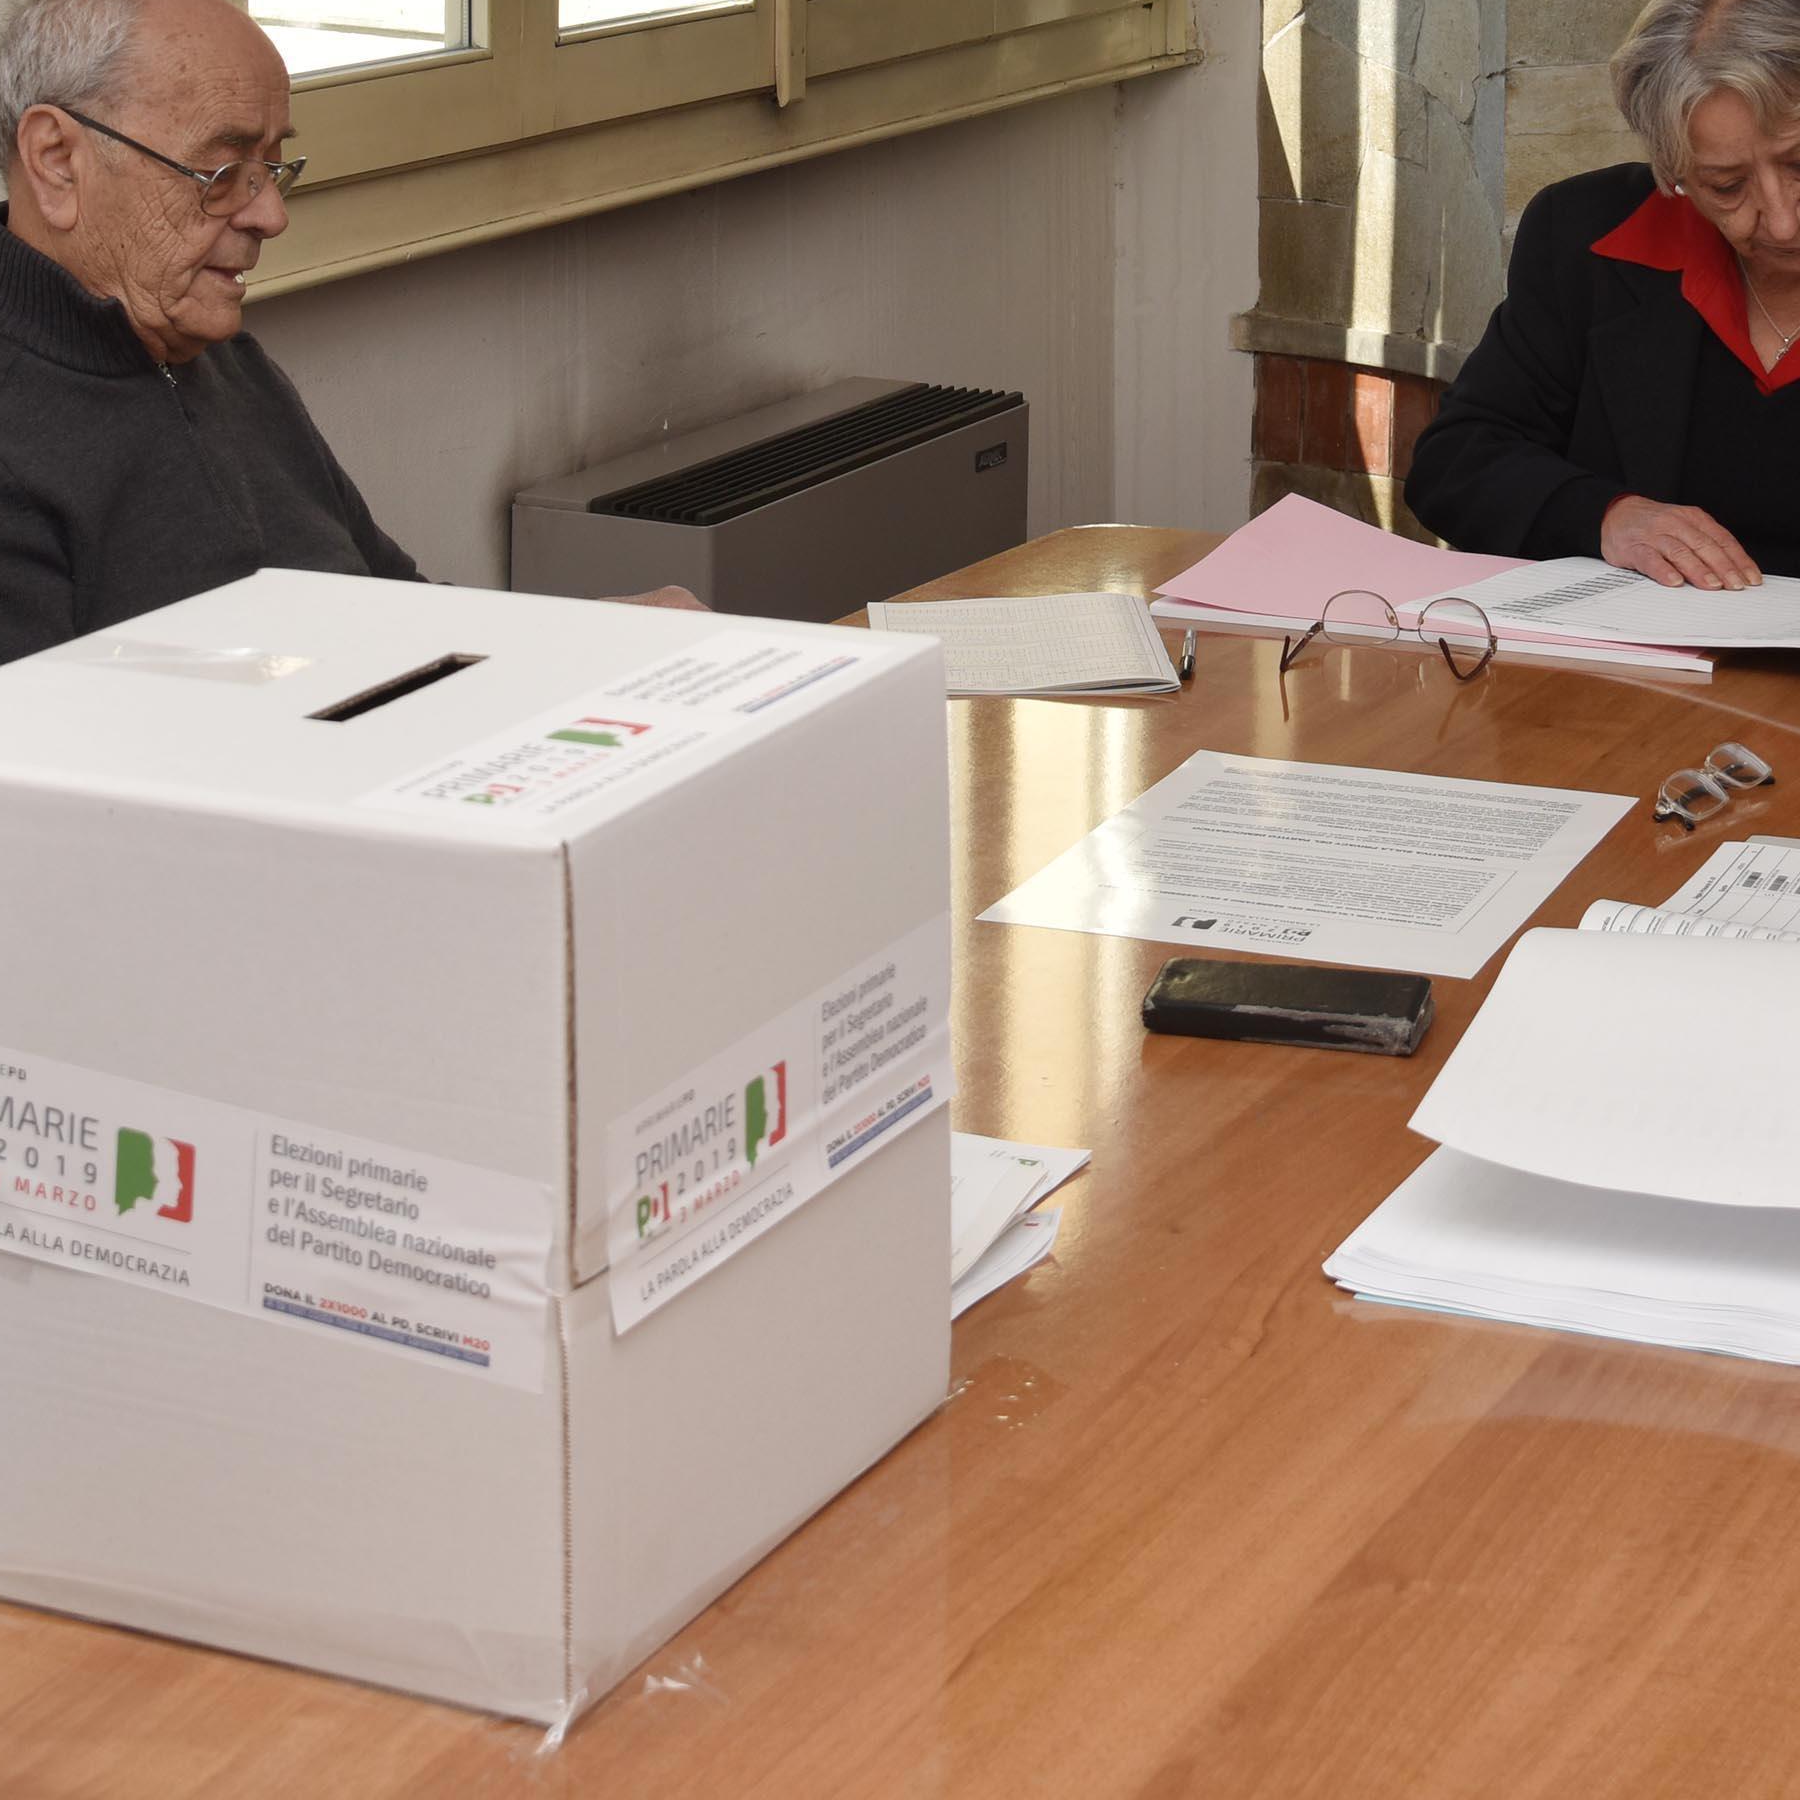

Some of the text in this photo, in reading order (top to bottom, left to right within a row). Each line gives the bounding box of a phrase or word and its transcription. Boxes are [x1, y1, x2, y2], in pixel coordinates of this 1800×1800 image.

[272, 1134, 429, 1193] Elezioni primarie
[636, 1092, 737, 1189] PRIMARIE
[677, 1137, 737, 1197] 2019
[14, 1176, 97, 1212] MARZO
[270, 1167, 420, 1222] per il Segretario
[20, 1227, 65, 1252] ALLA
[71, 1239, 191, 1287] DEMOCRAZIA
[266, 1223, 491, 1299] del Partito Democratico
[268, 1196, 497, 1271] e l'Assemblea nazionale
[641, 1182, 795, 1302] LA PAROLA ALLA DEMOCRAZIA
[264, 1282, 301, 1301] DONA
[306, 1293, 317, 1307] IL
[371, 1311, 389, 1326] AL
[417, 1322, 460, 1345] SCRIVI
